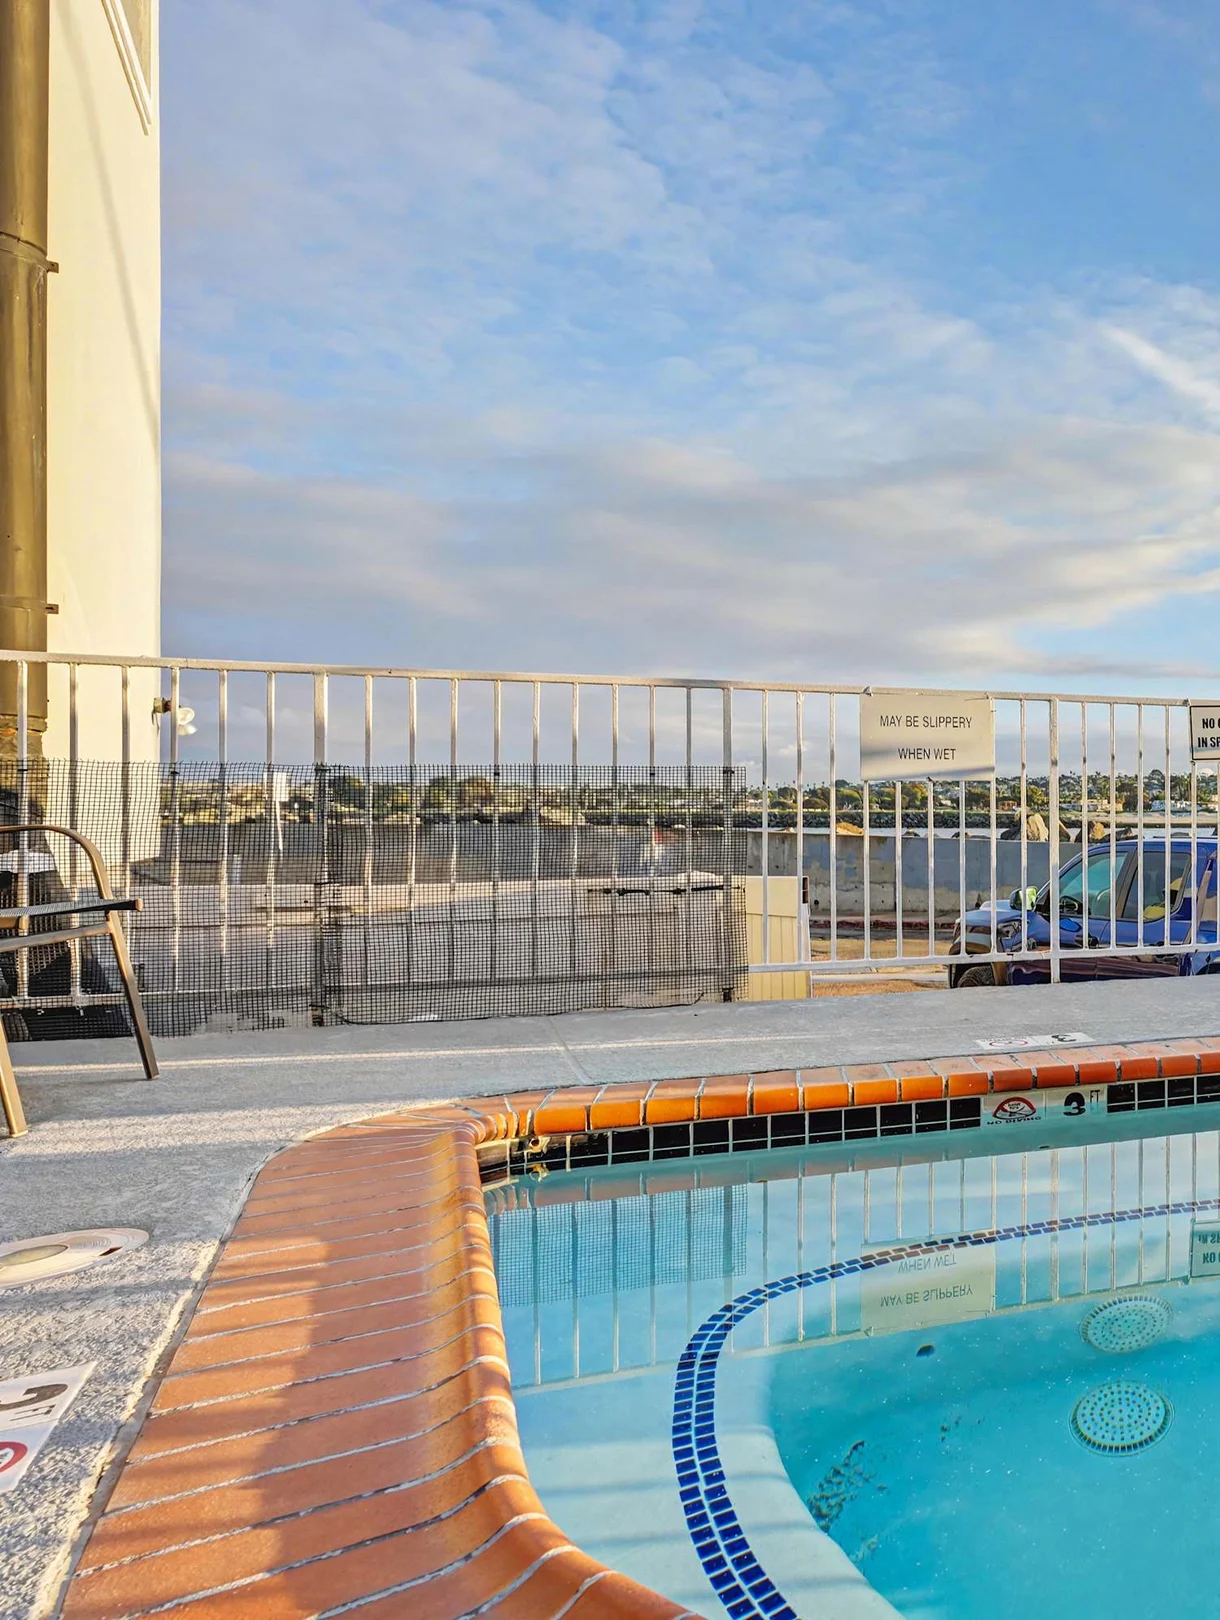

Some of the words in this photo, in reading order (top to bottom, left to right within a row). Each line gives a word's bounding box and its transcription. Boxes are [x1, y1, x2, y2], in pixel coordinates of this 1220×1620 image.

[880, 715, 902, 727] MAY
[905, 715, 919, 727] BE
[922, 716, 972, 728] SLIPPERY
[1202, 718, 1215, 729] NO
[1197, 736, 1208, 748] IN
[898, 748, 930, 760] WHEN
[933, 748, 956, 760] WET
[1064, 1092, 1086, 1116] 3
